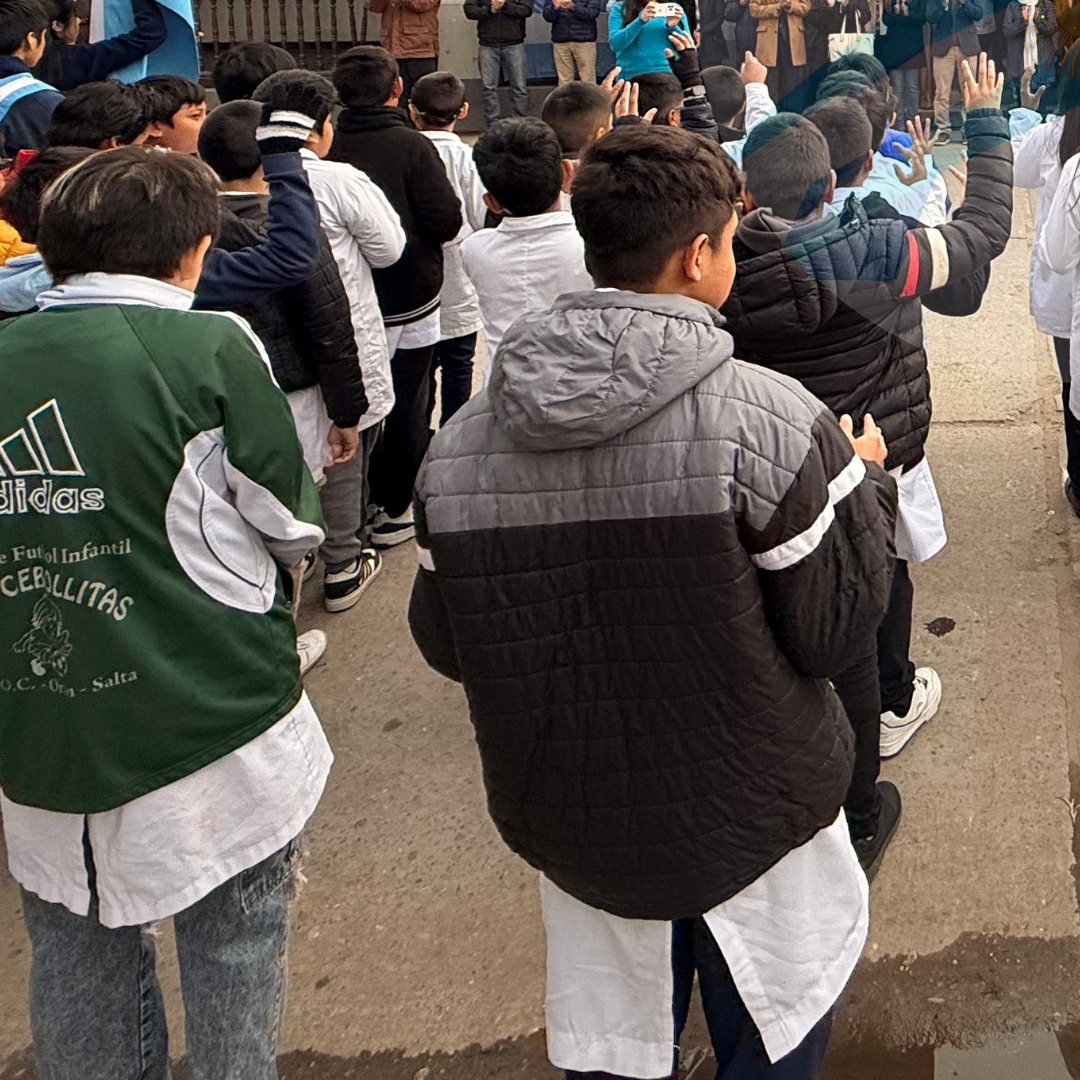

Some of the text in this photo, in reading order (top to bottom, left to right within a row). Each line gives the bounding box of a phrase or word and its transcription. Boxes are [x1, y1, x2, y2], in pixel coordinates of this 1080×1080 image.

[0, 478, 105, 515] didas
[11, 544, 58, 564] Futol
[61, 538, 131, 564] Infantil
[91, 670, 138, 693] Salta
